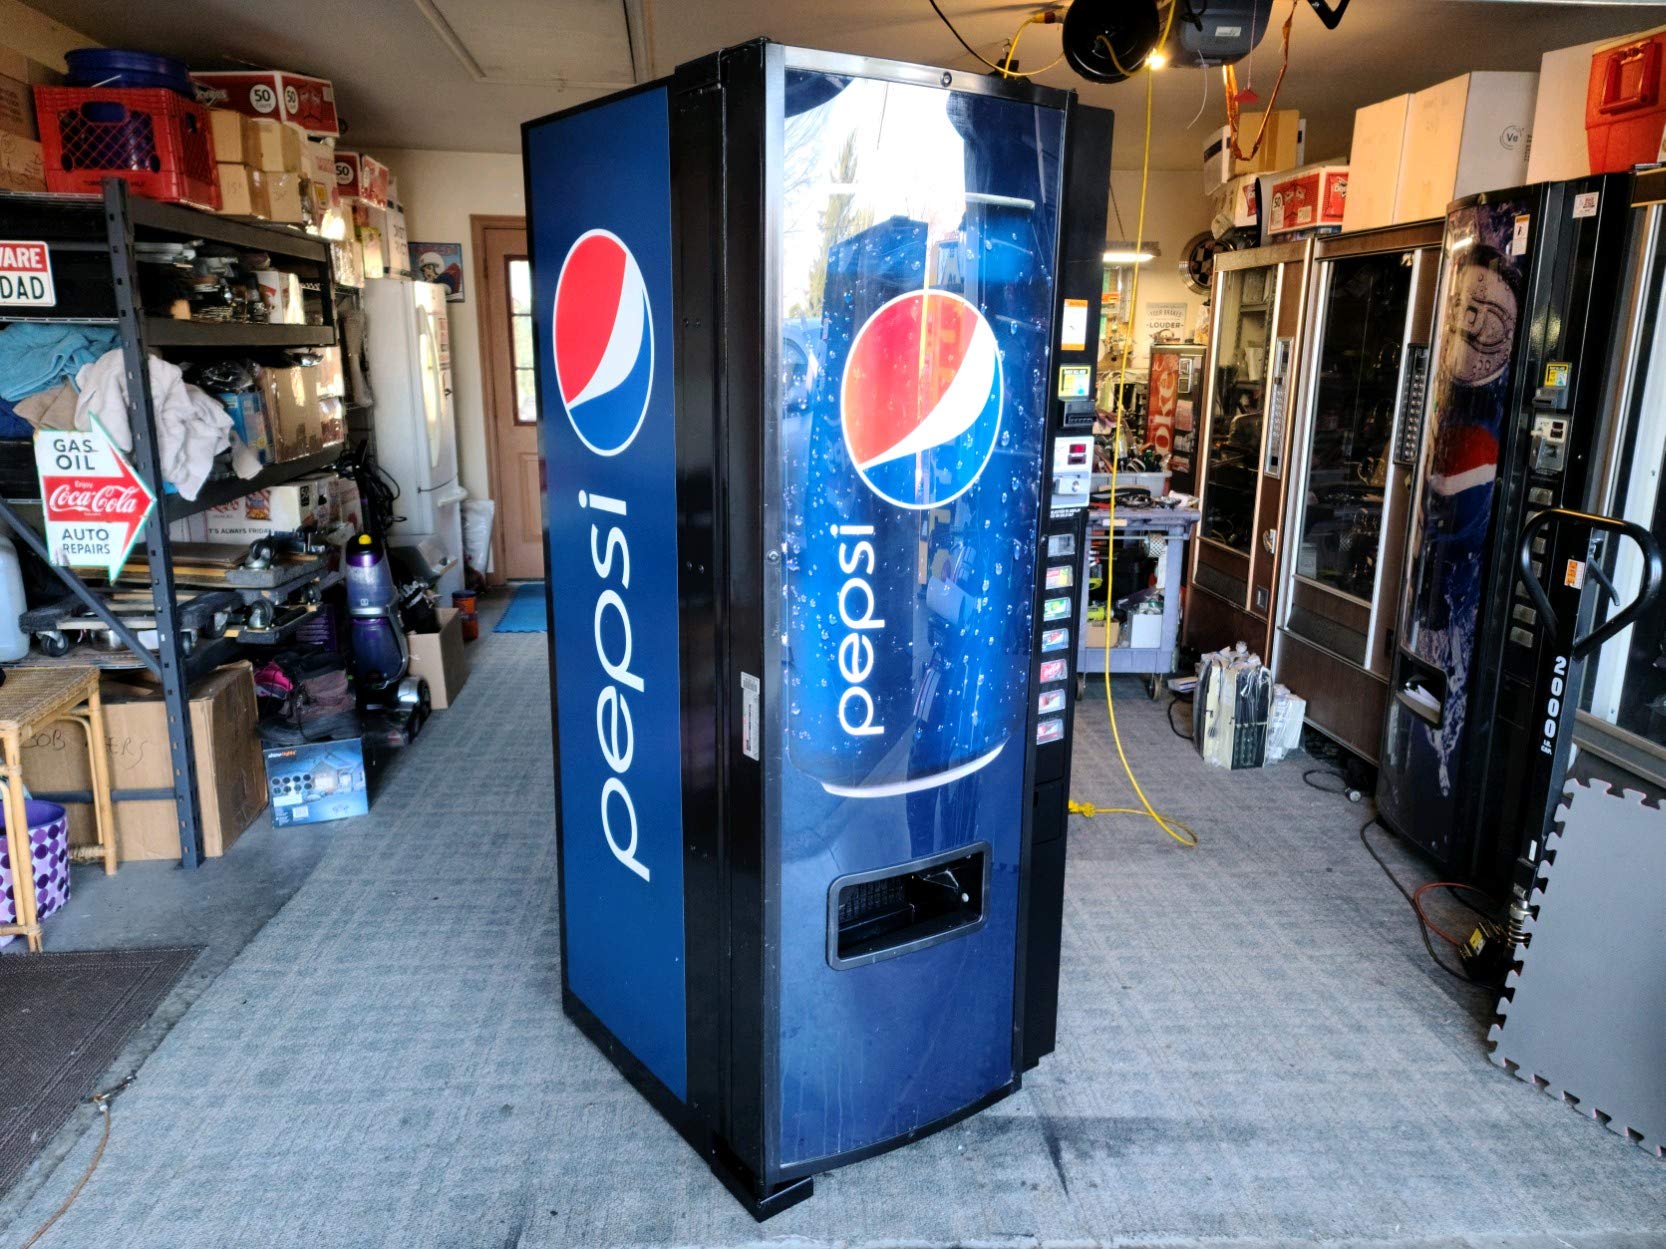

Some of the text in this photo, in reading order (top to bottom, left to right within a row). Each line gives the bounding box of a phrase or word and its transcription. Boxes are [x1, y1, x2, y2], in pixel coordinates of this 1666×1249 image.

[253, 89, 271, 102] 50
[286, 90, 296, 103] 50
[336, 165, 350, 177] 50
[0, 247, 43, 268] ARE
[0, 275, 45, 300] DAD
[1153, 368, 1176, 458] oke
[53, 439, 94, 452] GAS
[56, 455, 95, 470] OIL
[49, 485, 140, 513] Coca-Cola
[62, 529, 109, 541] AUTO
[62, 544, 111, 554] REPAIRS
[830, 524, 885, 736] pepsi
[578, 489, 650, 882] pepsi
